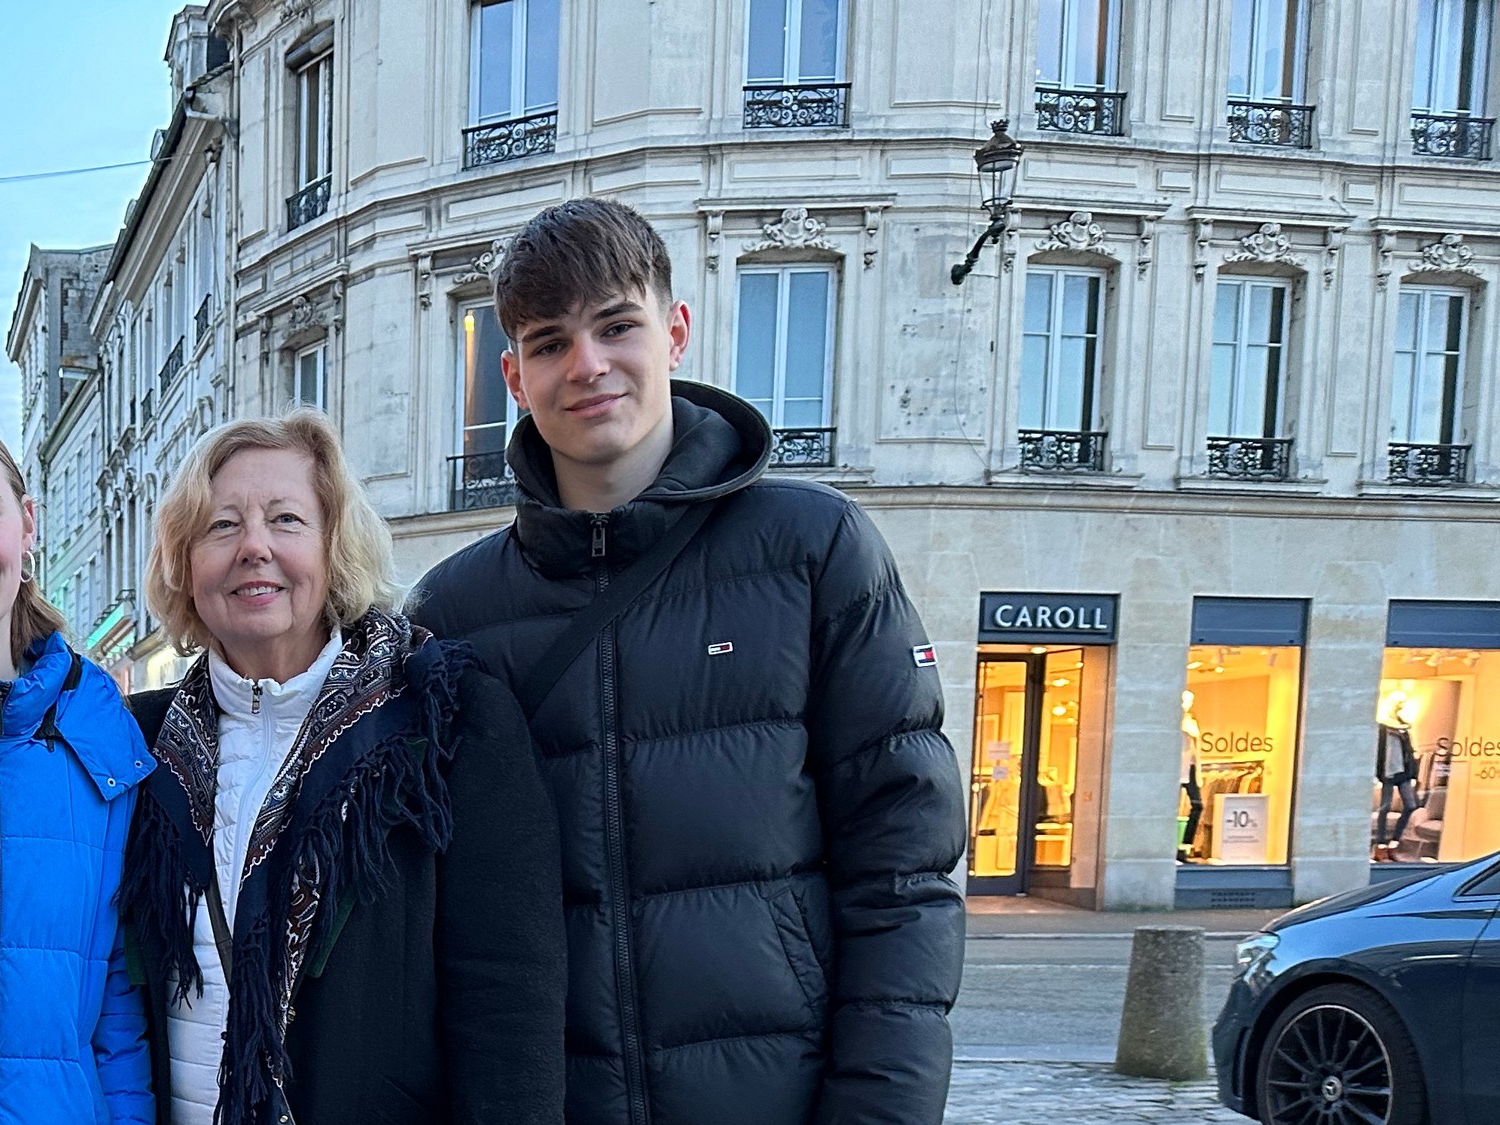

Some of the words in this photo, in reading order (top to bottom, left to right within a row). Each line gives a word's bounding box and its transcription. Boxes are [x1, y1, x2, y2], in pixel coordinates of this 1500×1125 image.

[994, 604, 1107, 629] CAROLL
[1200, 731, 1273, 753] Soldes
[1226, 811, 1258, 828] -10%
